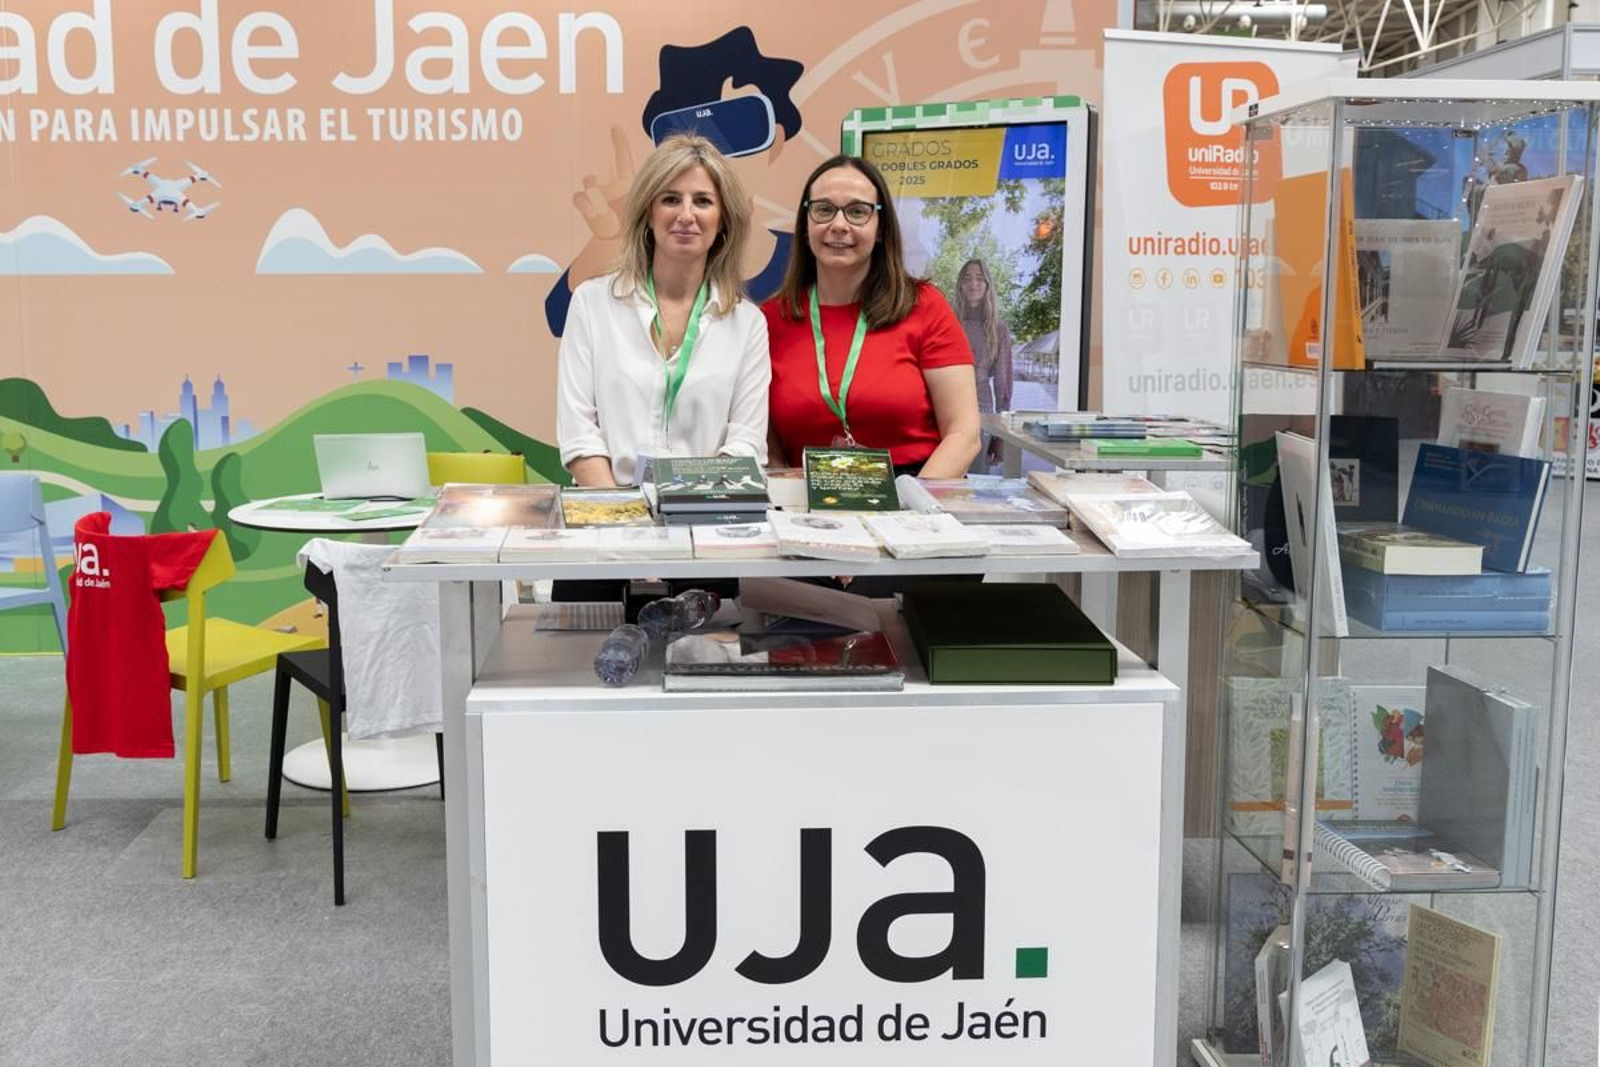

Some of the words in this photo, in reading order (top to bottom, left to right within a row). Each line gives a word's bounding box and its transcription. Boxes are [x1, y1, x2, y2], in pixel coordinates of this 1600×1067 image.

[154, 0, 300, 94] de
[31, 109, 118, 142] PARA
[131, 108, 307, 142] IMPULSAR
[320, 108, 356, 141] EL
[367, 107, 523, 141] TURISMO
[872, 140, 952, 159] GRADOS
[1188, 145, 1259, 164] uniRado
[881, 161, 926, 172] DOBLES
[928, 159, 979, 170] GRADOS
[899, 175, 926, 186] 2025
[598, 1004, 864, 1048] Universidad
[876, 1002, 930, 1042] de
[941, 998, 1048, 1041] Jaén
